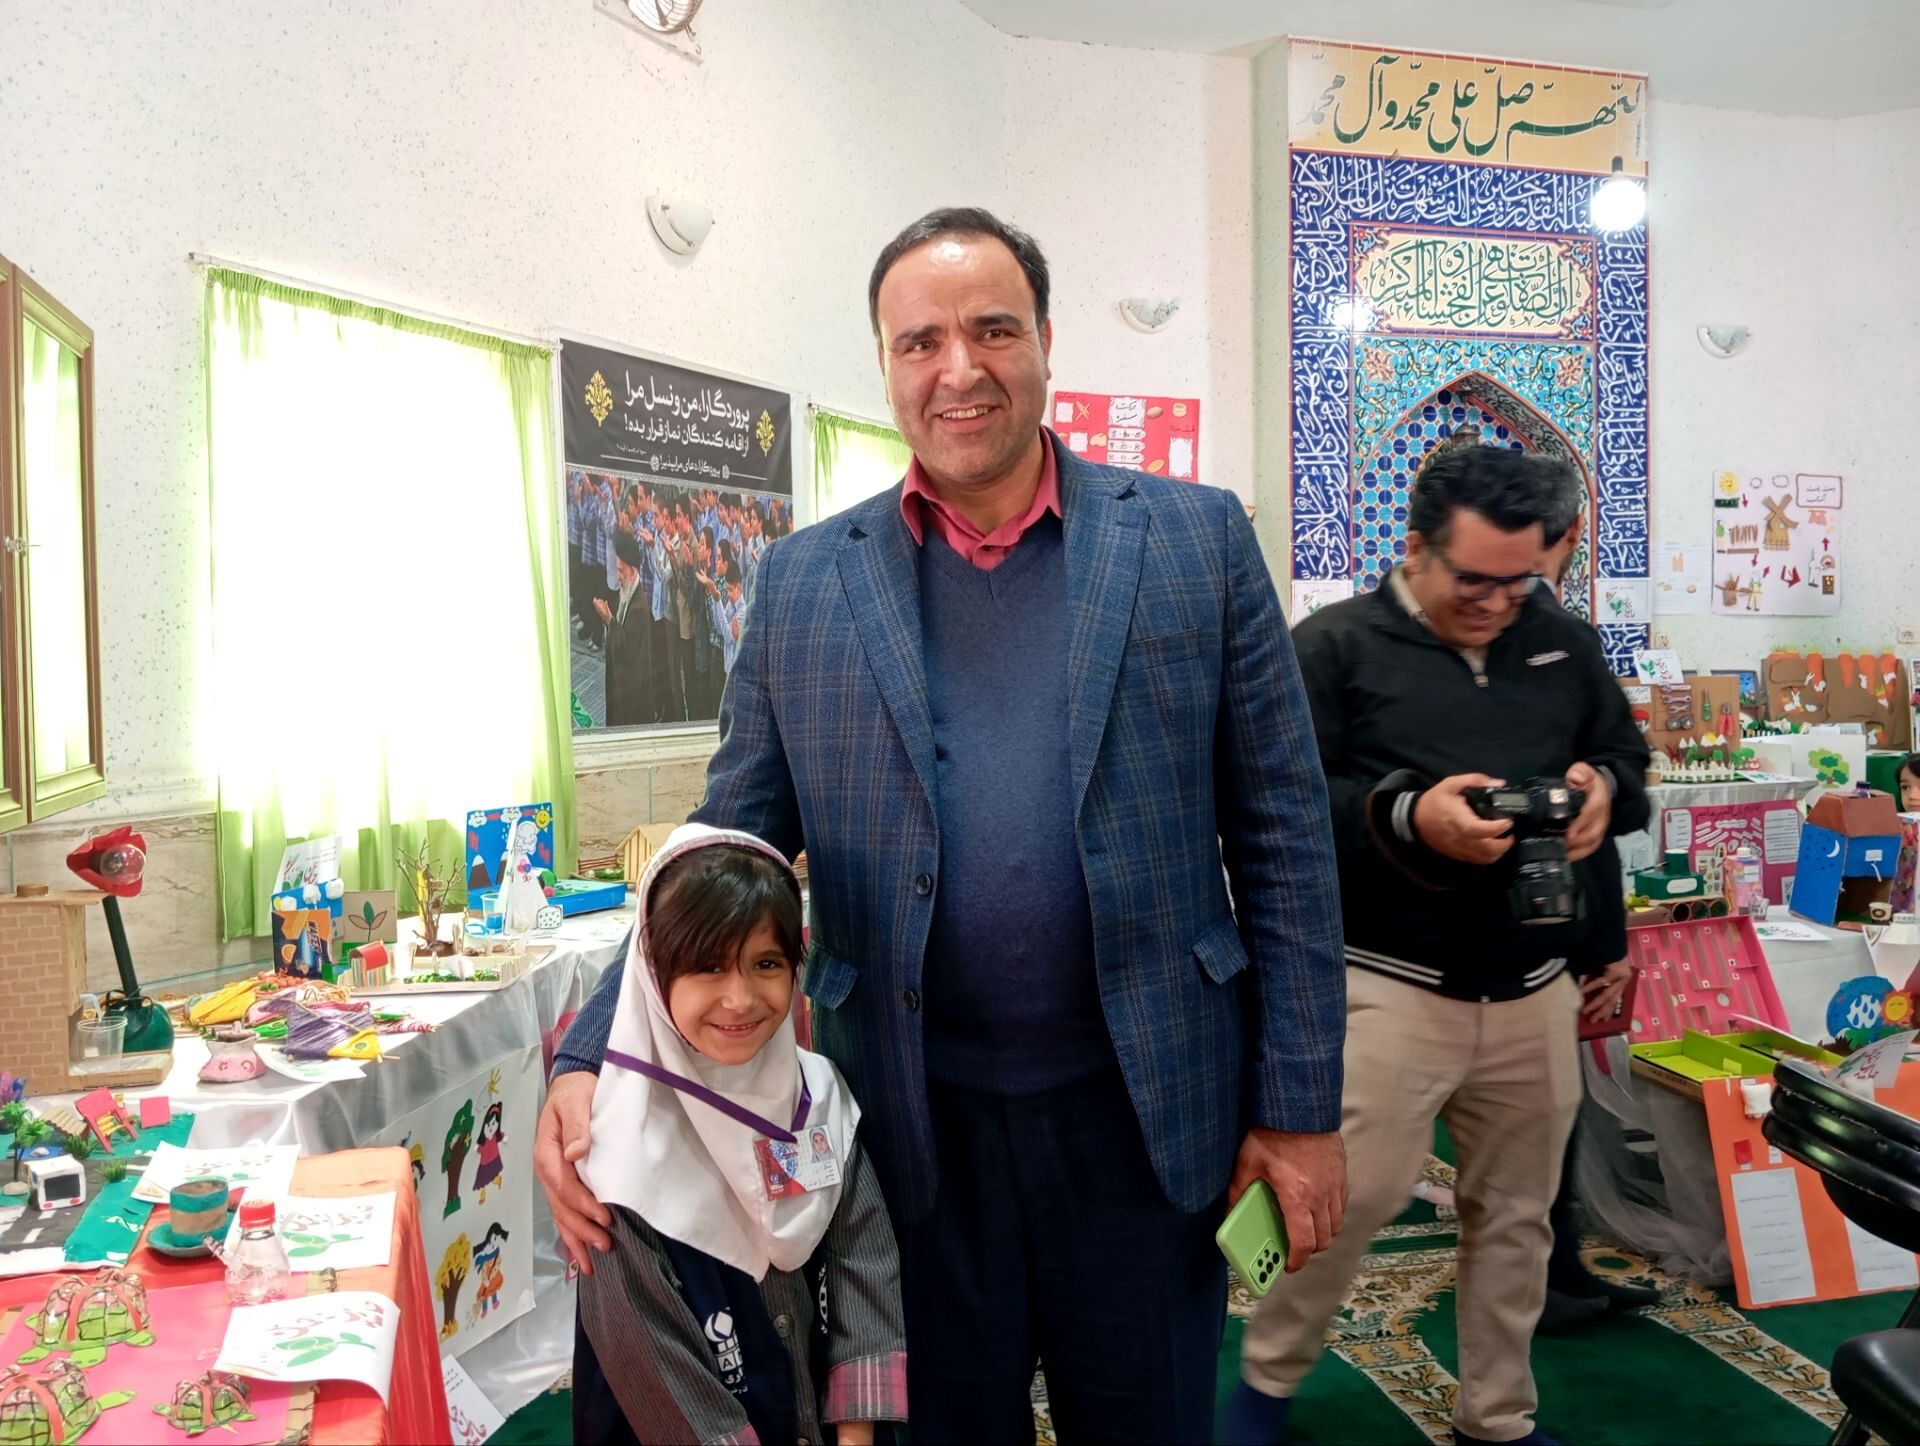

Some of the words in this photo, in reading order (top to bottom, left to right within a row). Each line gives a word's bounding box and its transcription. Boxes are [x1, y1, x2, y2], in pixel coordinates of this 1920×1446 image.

[624, 369, 645, 407] مرا
[644, 375, 673, 411] نسل
[671, 394, 680, 416] و
[681, 396, 698, 419] من
[645, 416, 663, 441] قرار
[662, 419, 681, 443] نماز
[681, 423, 724, 448] کنندگان
